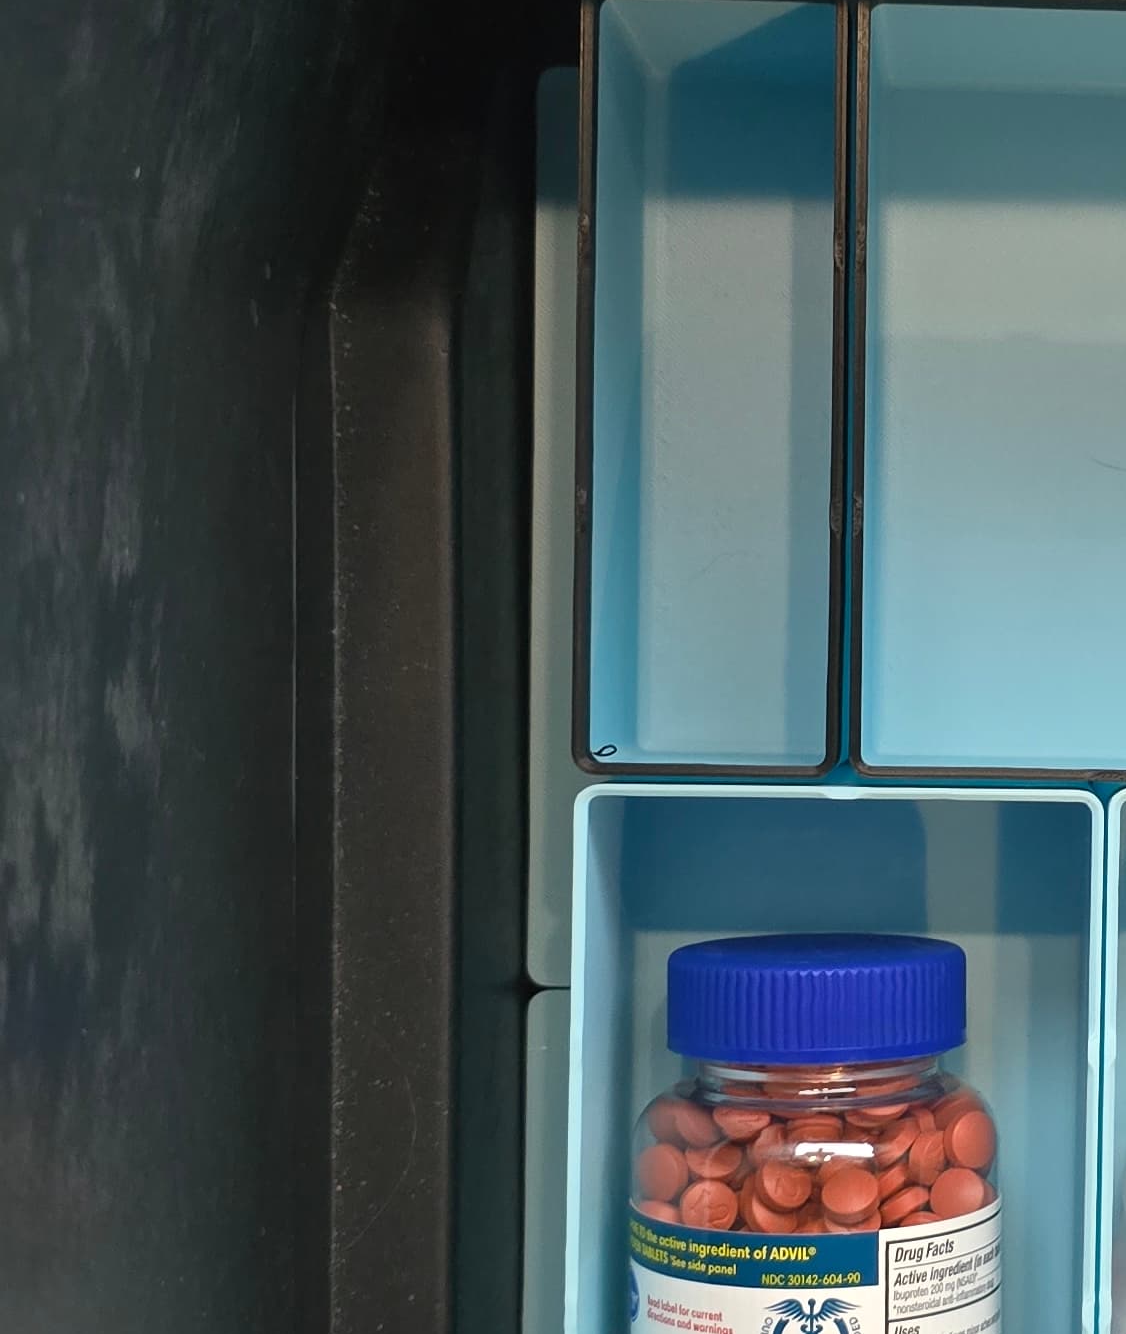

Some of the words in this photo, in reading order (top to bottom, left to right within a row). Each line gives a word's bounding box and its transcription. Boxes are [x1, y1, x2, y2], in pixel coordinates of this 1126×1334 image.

[659, 1235, 687, 1251] active
[689, 1238, 750, 1260] ingredient
[753, 1245, 767, 1259] of
[894, 1247, 923, 1263] Drug
[926, 1239, 955, 1258] Facts
[688, 1259, 706, 1272] side
[708, 1264, 737, 1276] panel
[761, 1274, 785, 1286] NDC
[787, 1272, 861, 1286] 30142-604-90
[893, 1269, 928, 1287] Active
[661, 1299, 678, 1312] label
[679, 1304, 690, 1316] for
[691, 1310, 723, 1323] current
[677, 1319, 692, 1331] and
